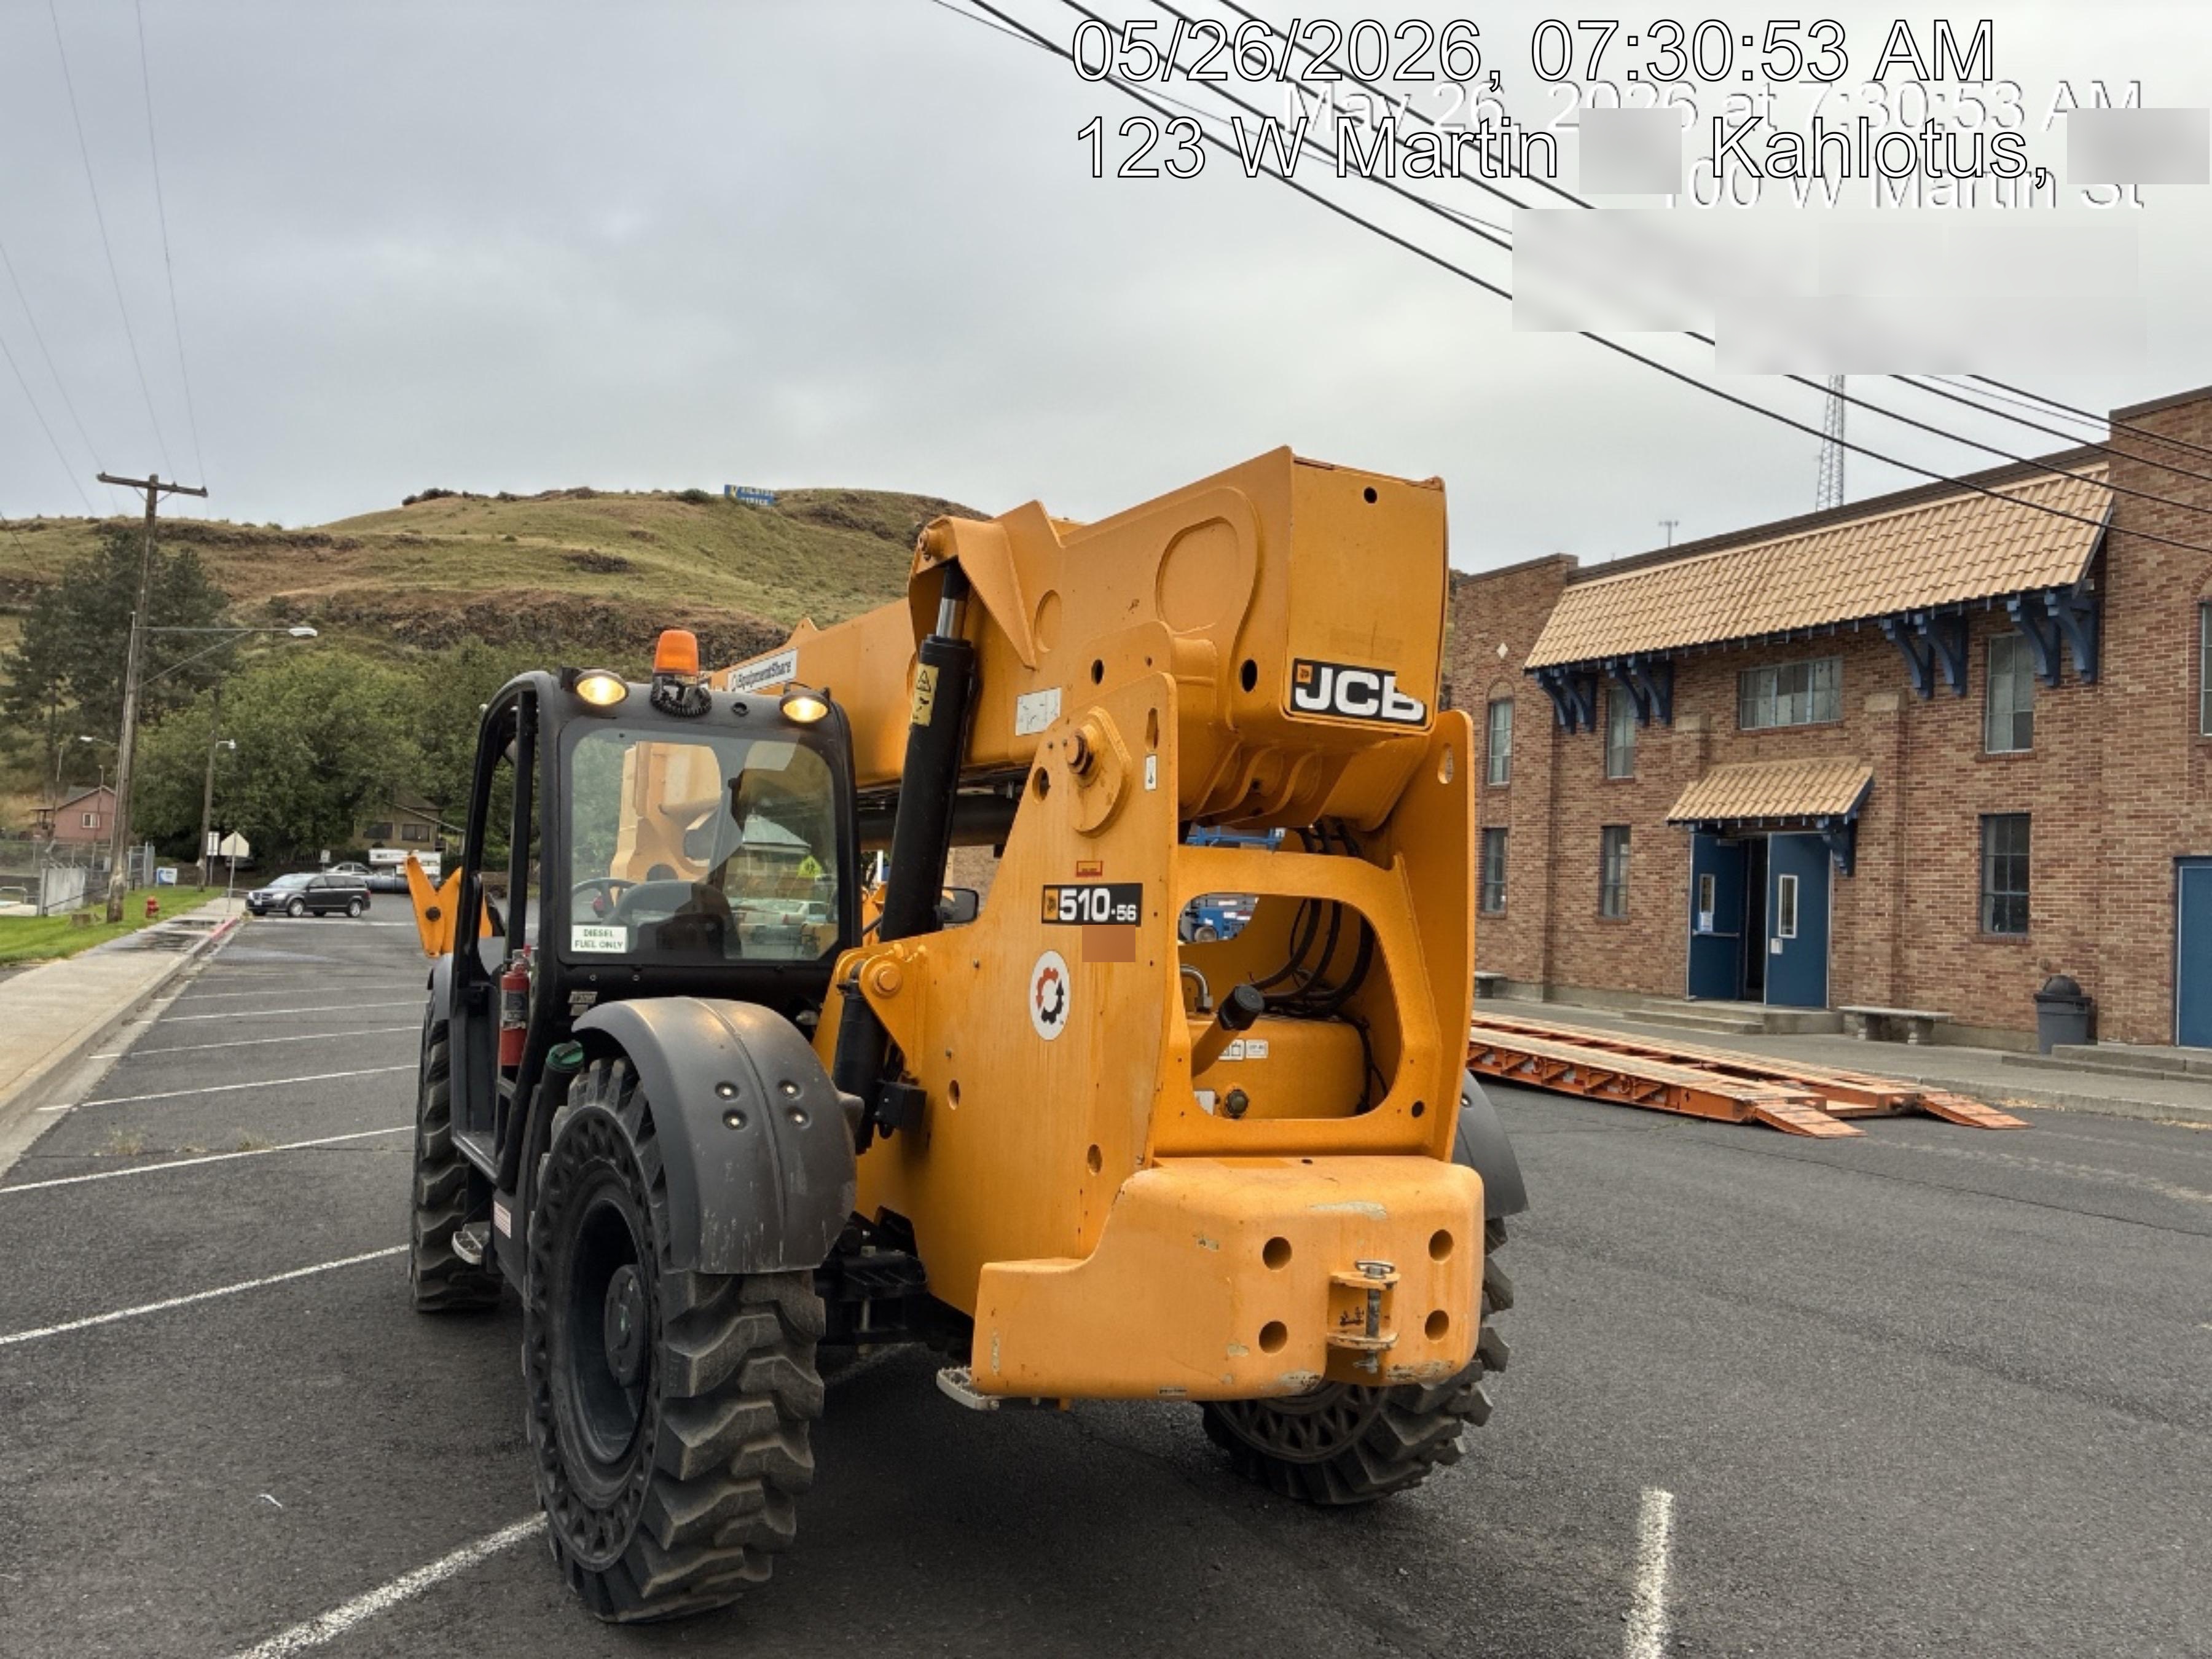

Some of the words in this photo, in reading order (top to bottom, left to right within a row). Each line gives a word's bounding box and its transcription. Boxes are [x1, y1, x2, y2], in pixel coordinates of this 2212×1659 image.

[583, 928, 613, 937] DIESEL
[575, 939, 597, 948] FUEL
[599, 941, 624, 949] ONLY
